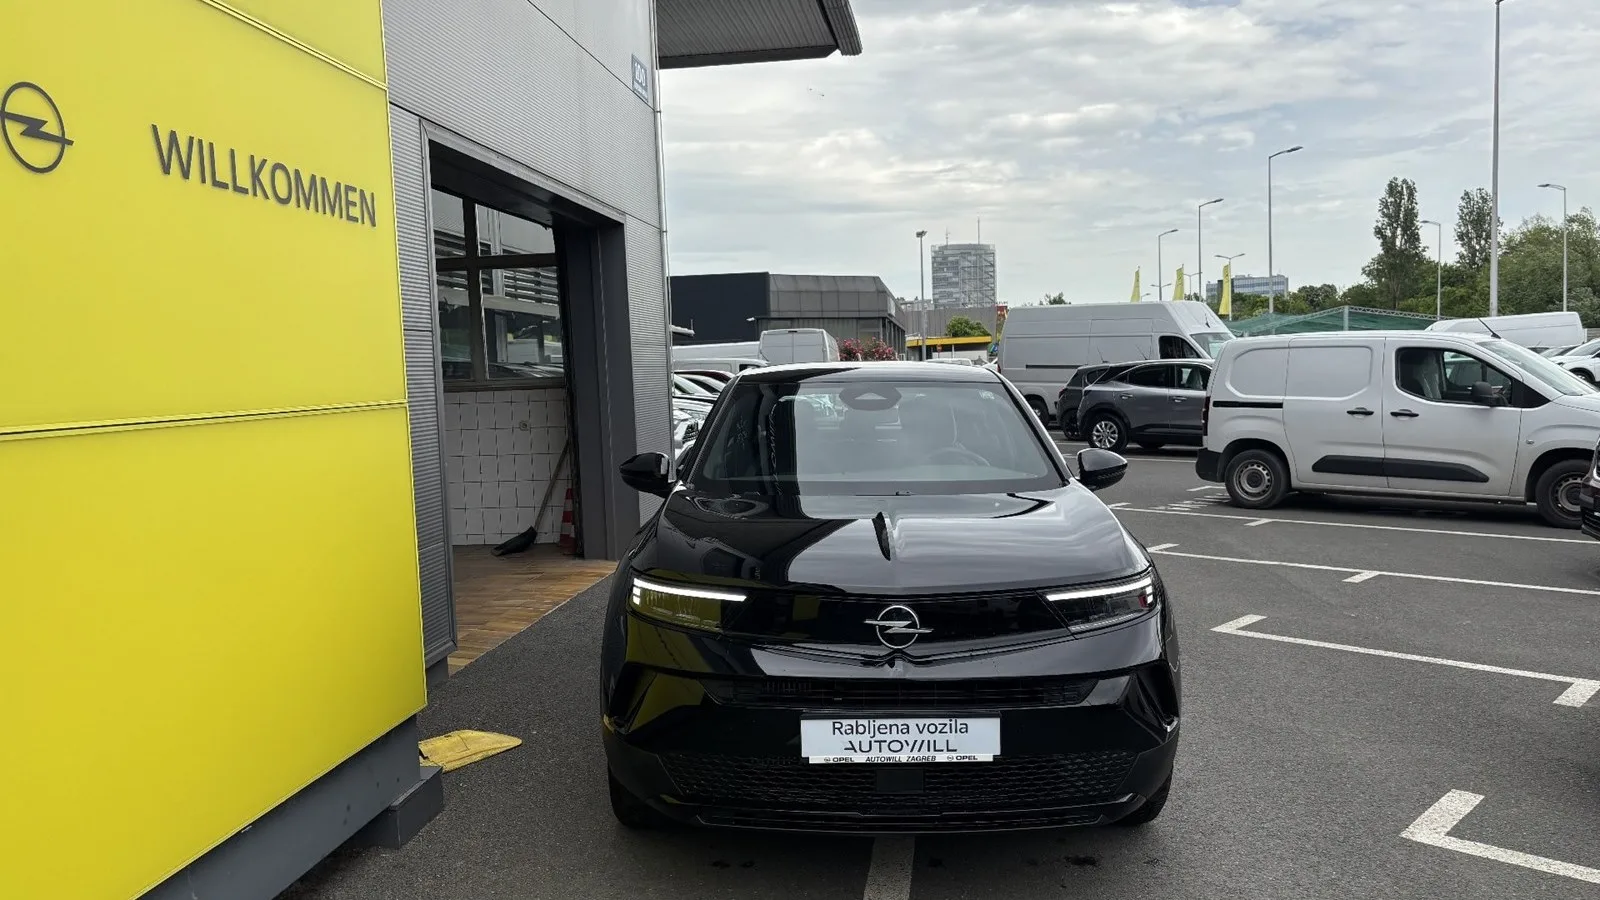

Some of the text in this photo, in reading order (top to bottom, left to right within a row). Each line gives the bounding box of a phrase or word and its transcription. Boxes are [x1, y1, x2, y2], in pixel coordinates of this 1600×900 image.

[151, 123, 377, 228] WILLKOMMEN
[832, 719, 969, 739] Rabljena vozila
[843, 739, 958, 753] AUTOWILL
